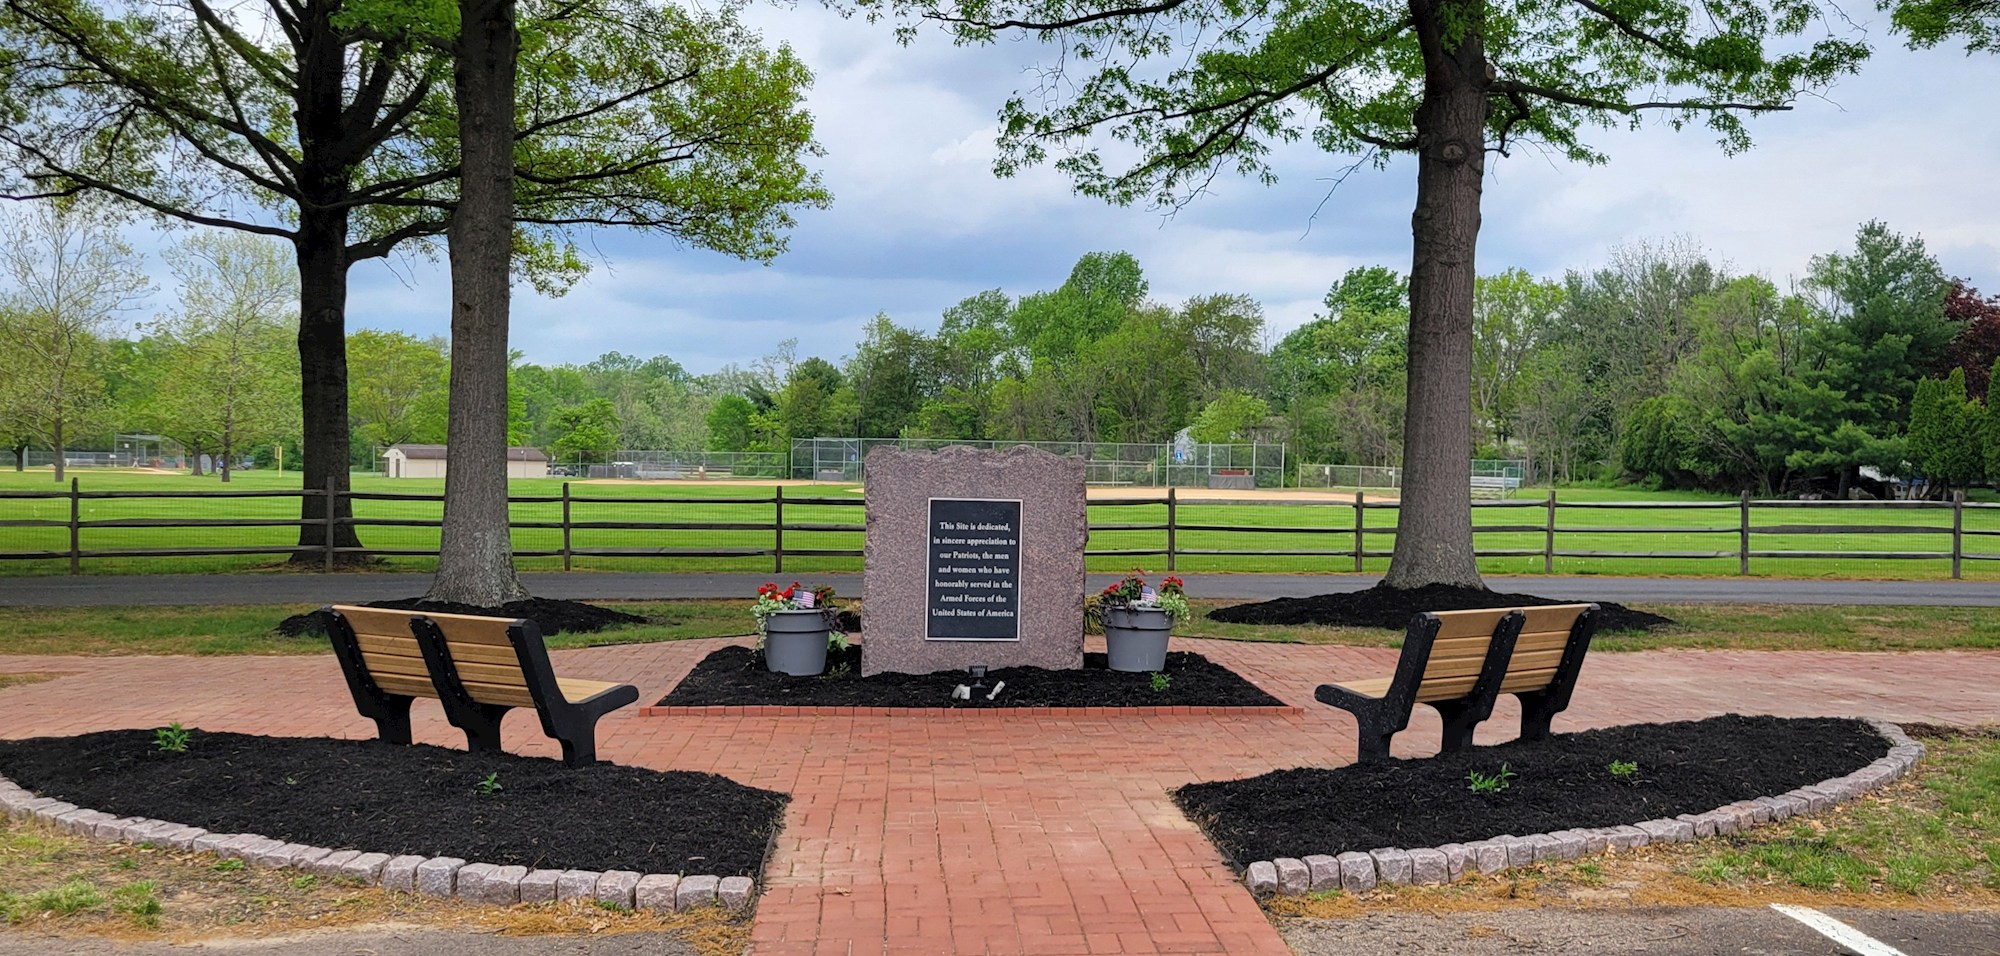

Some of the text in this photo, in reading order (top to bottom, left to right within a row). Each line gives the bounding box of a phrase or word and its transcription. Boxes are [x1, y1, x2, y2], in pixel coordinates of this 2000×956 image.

[940, 522, 954, 530] This
[977, 523, 1010, 532] dedicated,
[967, 538, 1007, 546] appreciation
[953, 552, 980, 560] Patriots,
[994, 566, 1010, 574] have
[935, 580, 968, 589] honorably
[986, 609, 1014, 617] America
